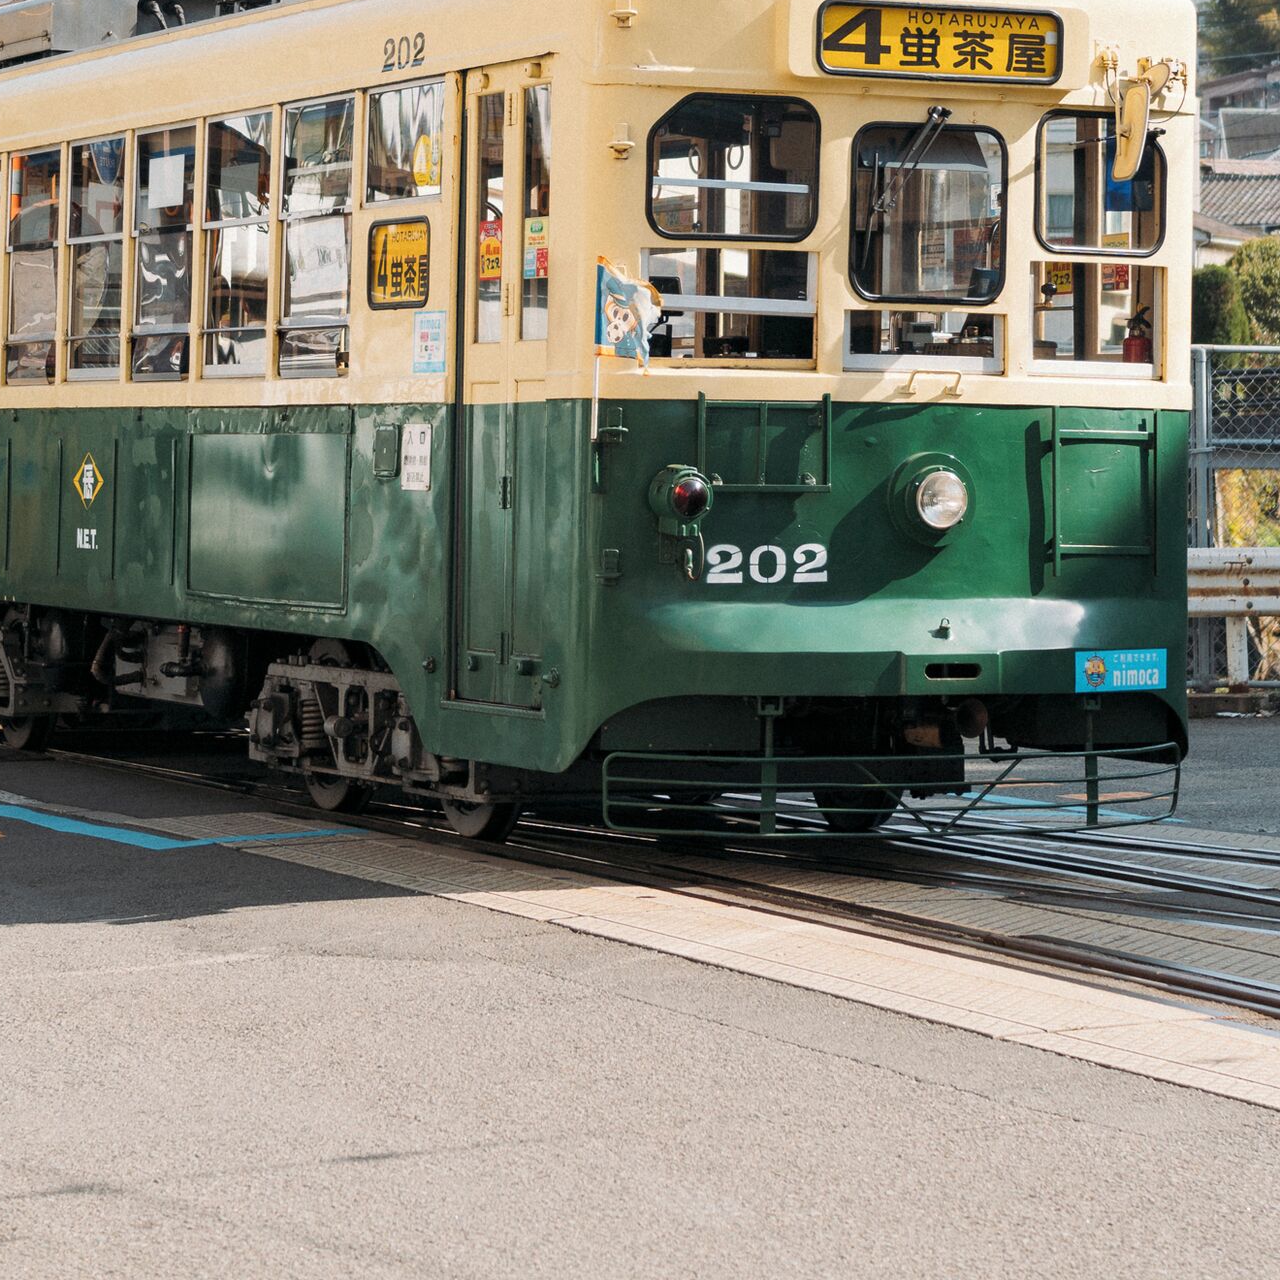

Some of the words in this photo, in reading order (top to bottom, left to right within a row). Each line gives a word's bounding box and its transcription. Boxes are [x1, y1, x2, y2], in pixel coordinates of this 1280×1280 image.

[382, 32, 426, 72] 202
[823, 8, 891, 65] 4
[908, 11, 1040, 31] HOTARUJAYA
[899, 26, 1047, 73] 蛍茶屋
[377, 233, 388, 299] 4
[706, 543, 828, 584] 202
[1113, 664, 1159, 686] nimoca
